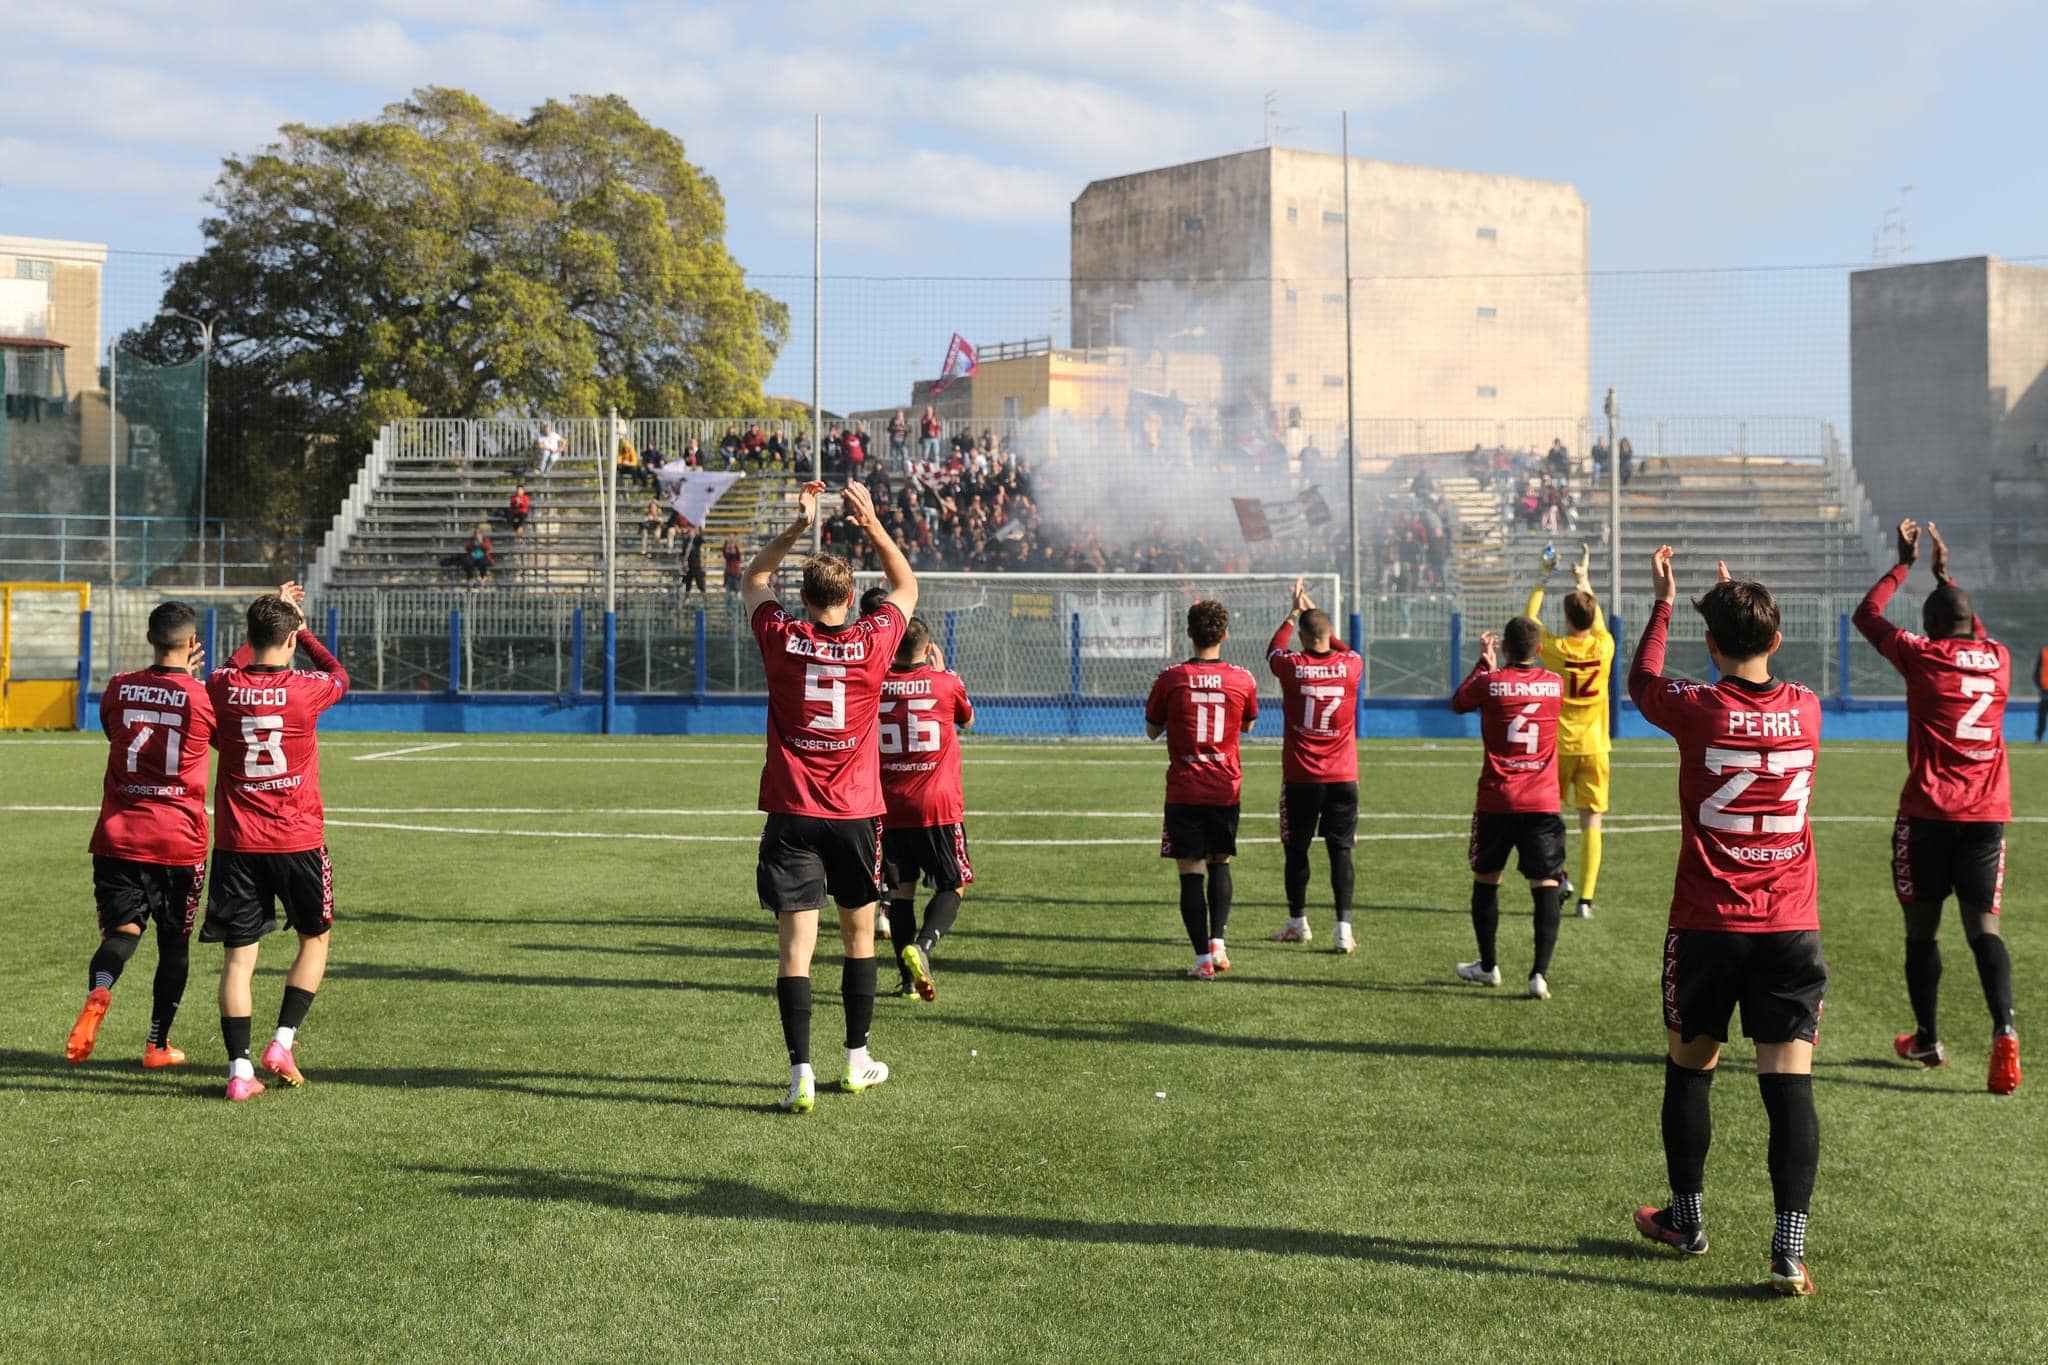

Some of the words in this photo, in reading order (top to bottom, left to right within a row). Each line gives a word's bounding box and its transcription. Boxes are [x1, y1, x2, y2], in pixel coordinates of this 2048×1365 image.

[785, 635, 865, 660] BOLZICCO
[1189, 674, 1222, 689] LIKA
[1296, 662, 1347, 679] BARILLÀ
[1565, 660, 1600, 698] 12
[119, 684, 188, 707] PORCINO
[227, 686, 287, 706] ZUCCO
[880, 680, 932, 696] PARODI
[1191, 692, 1226, 743] 11
[1300, 686, 1345, 730] 17
[1729, 708, 1802, 737] PERRI
[1955, 676, 1996, 742] 2
[1507, 703, 1542, 754] 4
[241, 715, 288, 778] 8
[1699, 747, 1814, 834] 23
[1730, 842, 1805, 862] SOSETEG.IT
